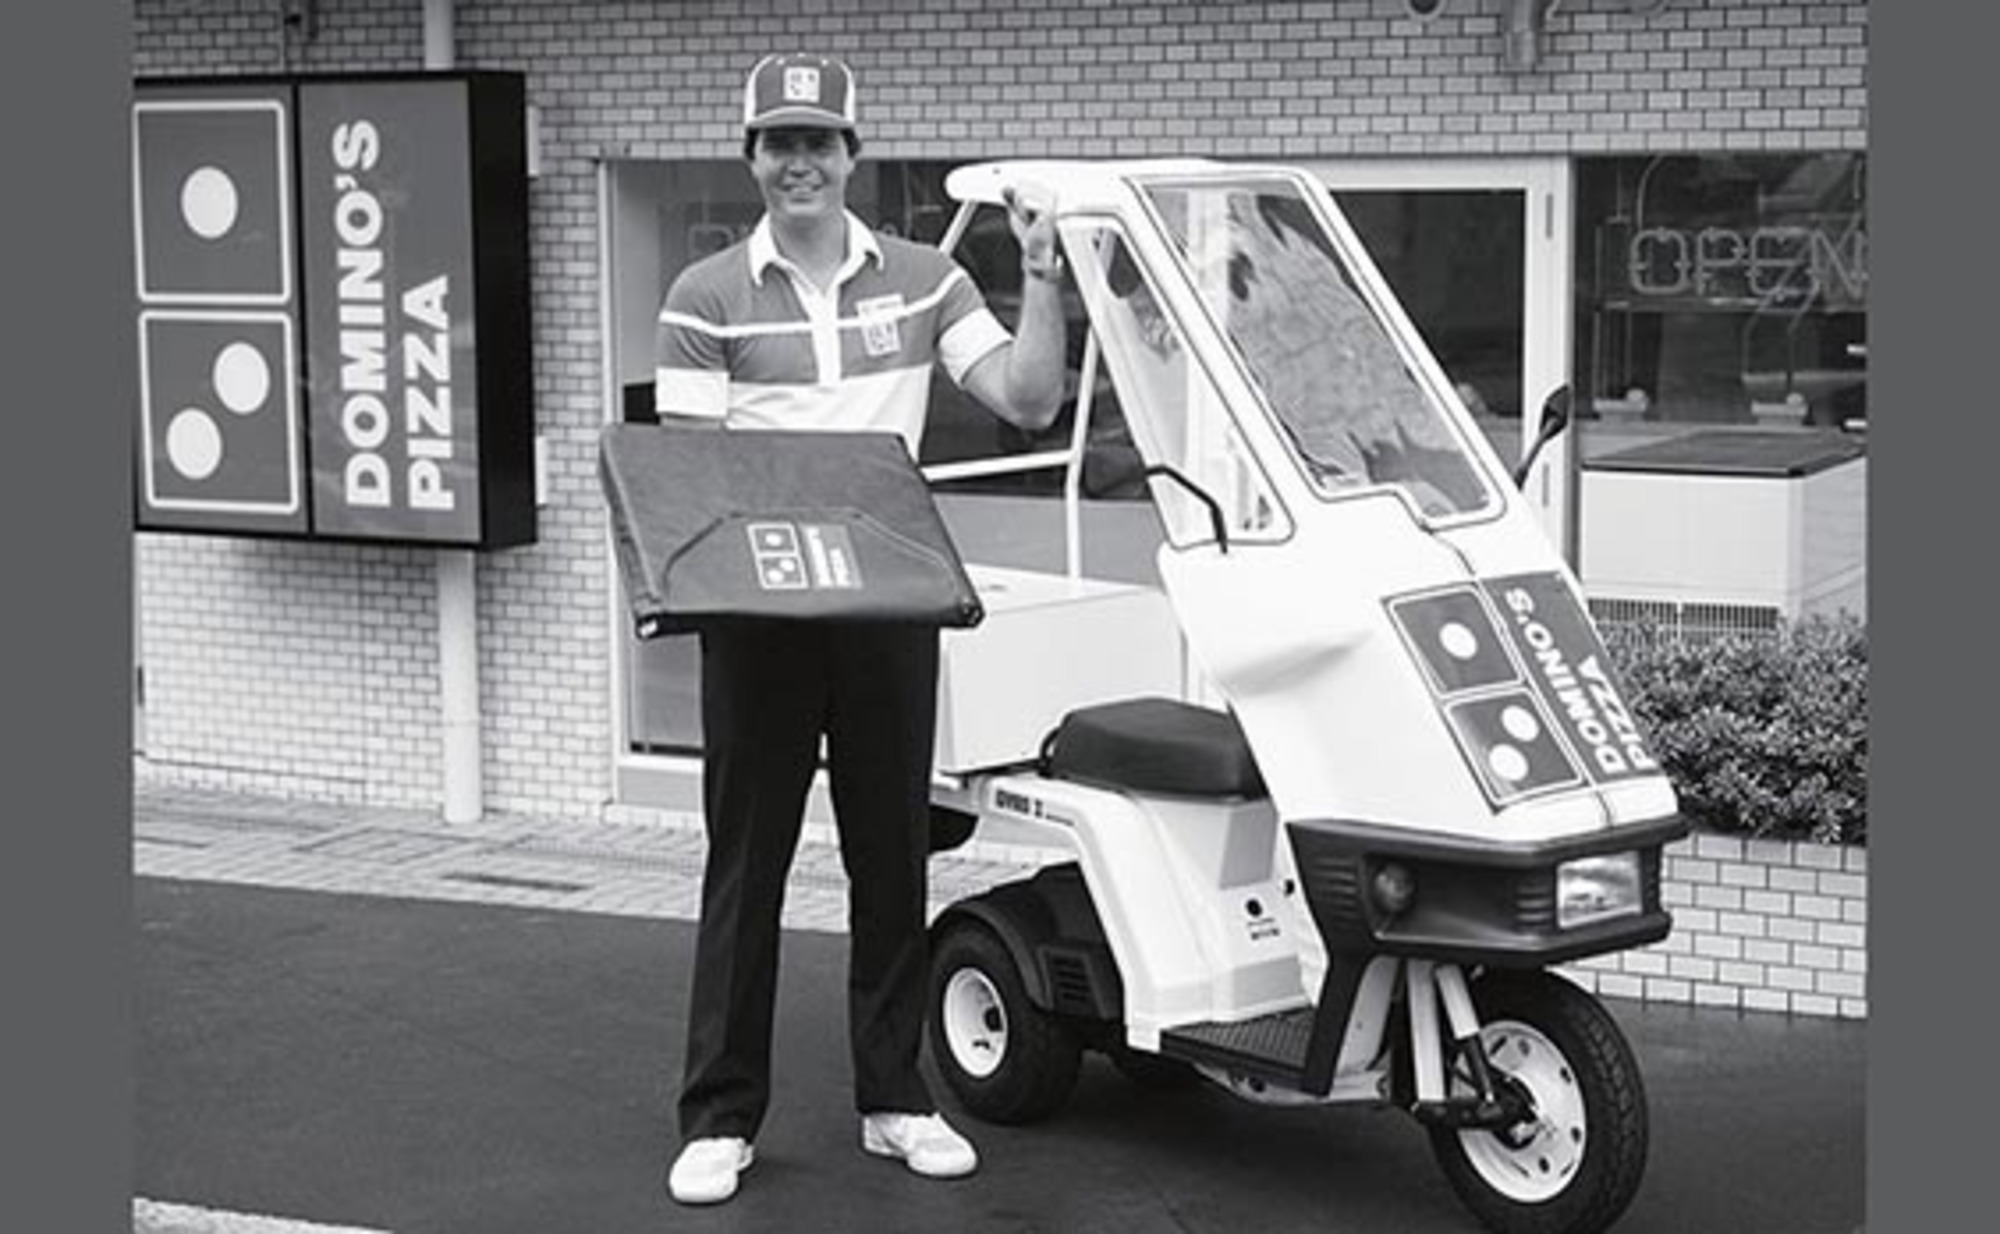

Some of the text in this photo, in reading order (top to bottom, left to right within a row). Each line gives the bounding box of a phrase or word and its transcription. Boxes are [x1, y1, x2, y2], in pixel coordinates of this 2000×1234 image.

[333, 120, 391, 506] DOMINO'S
[1629, 226, 1867, 299] OPEN
[403, 275, 455, 511] PIZZA
[1505, 588, 1628, 774] DOMINO'S
[1578, 655, 1657, 769] PIZZA
